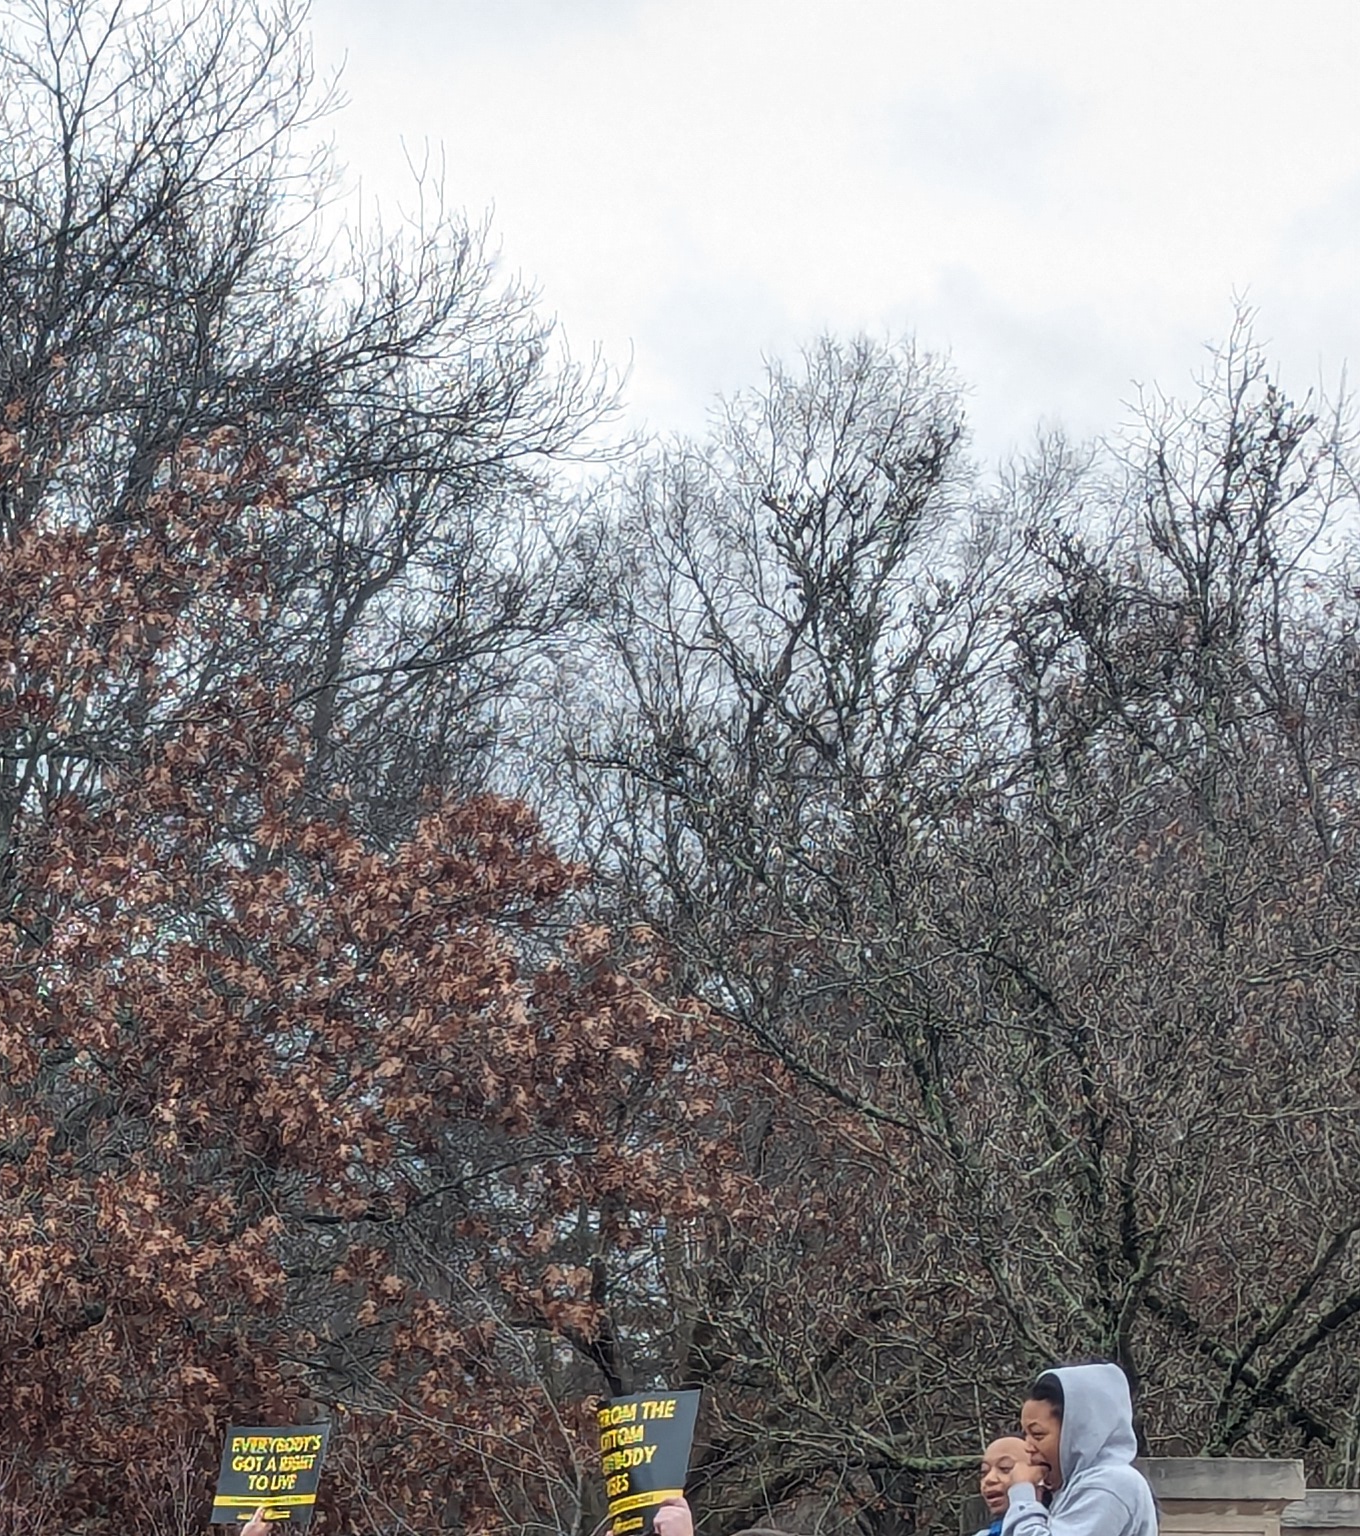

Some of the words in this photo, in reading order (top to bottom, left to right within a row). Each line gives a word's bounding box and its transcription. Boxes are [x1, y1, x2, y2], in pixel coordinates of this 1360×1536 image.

[641, 1400, 676, 1420] THE
[232, 1435, 322, 1453] EVERYBODY'S
[232, 1455, 264, 1472] GOT
[265, 1455, 276, 1472] A
[279, 1454, 316, 1472] RIGHT
[248, 1474, 269, 1491] TO
[270, 1474, 298, 1491] LIVE
